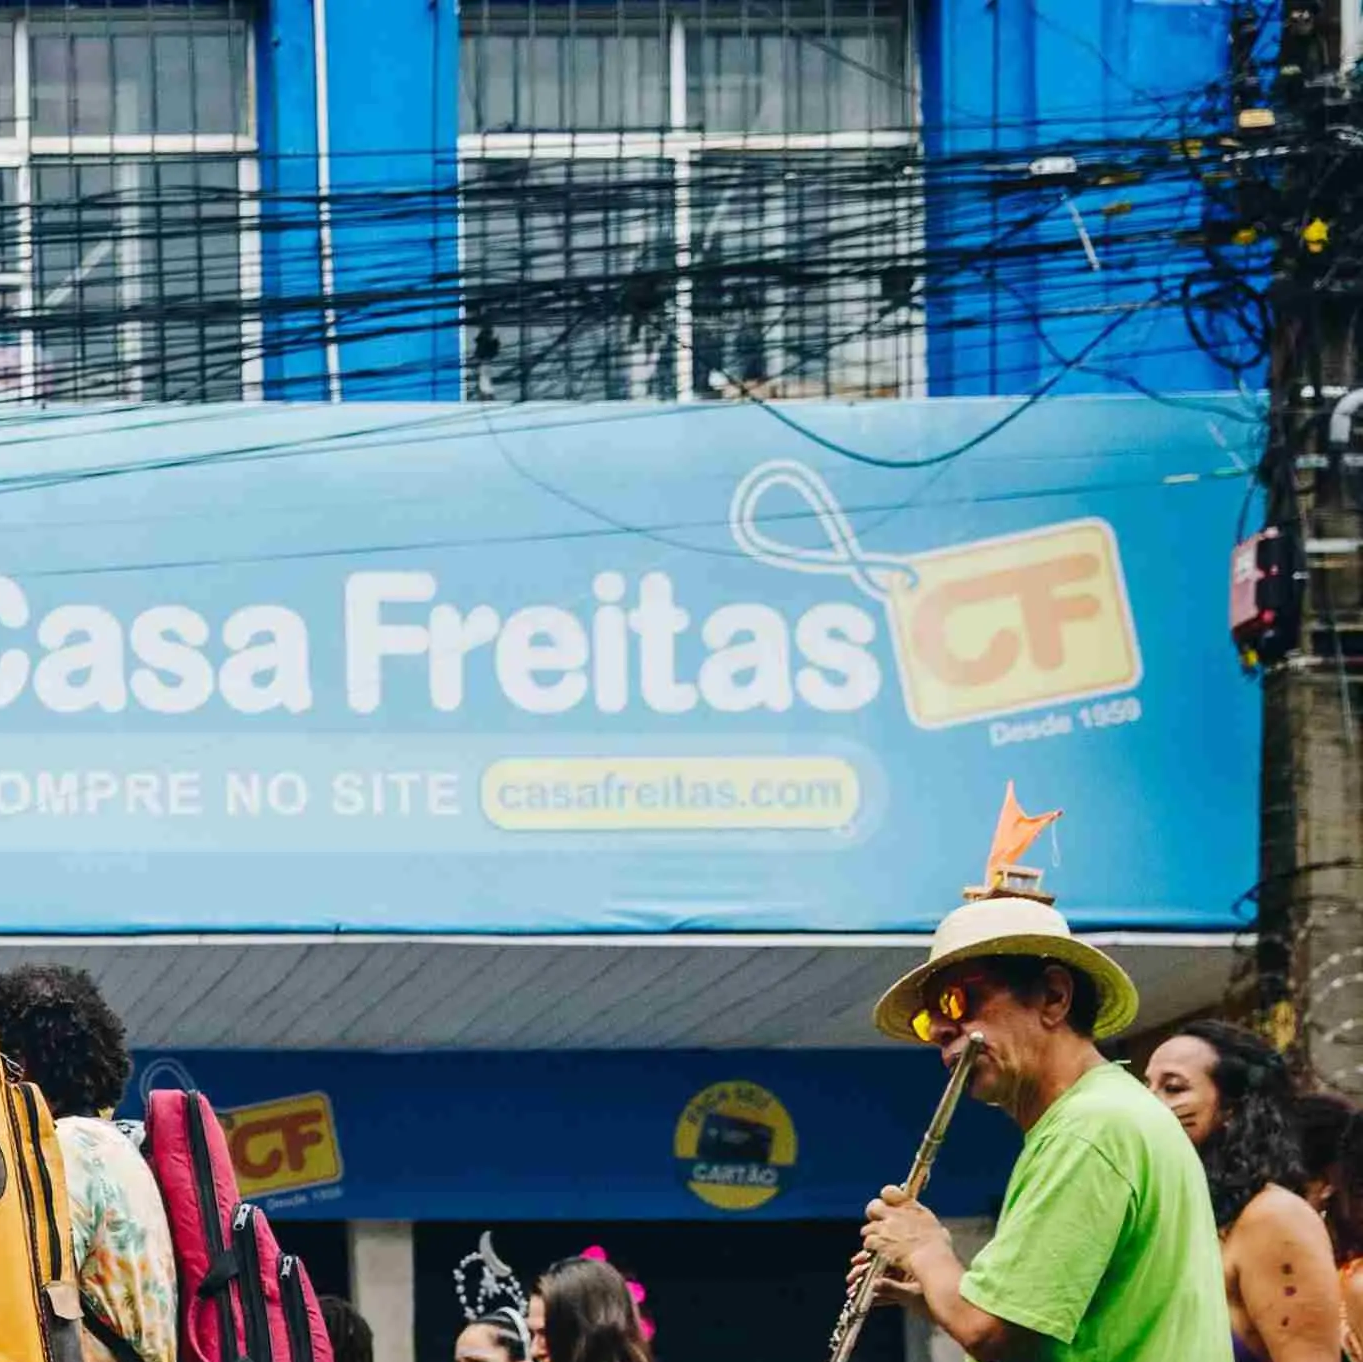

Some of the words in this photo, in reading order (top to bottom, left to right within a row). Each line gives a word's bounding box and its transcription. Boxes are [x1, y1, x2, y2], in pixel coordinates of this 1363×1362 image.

[345, 571, 882, 714] Freitas
[912, 552, 1101, 687] CF
[989, 715, 1073, 747] Desde
[226, 772, 307, 816] NO
[331, 771, 461, 816] SITE
[497, 776, 843, 812] casafreitas.com
[232, 1109, 323, 1179] CF
[692, 1163, 777, 1185] CARTÃO
